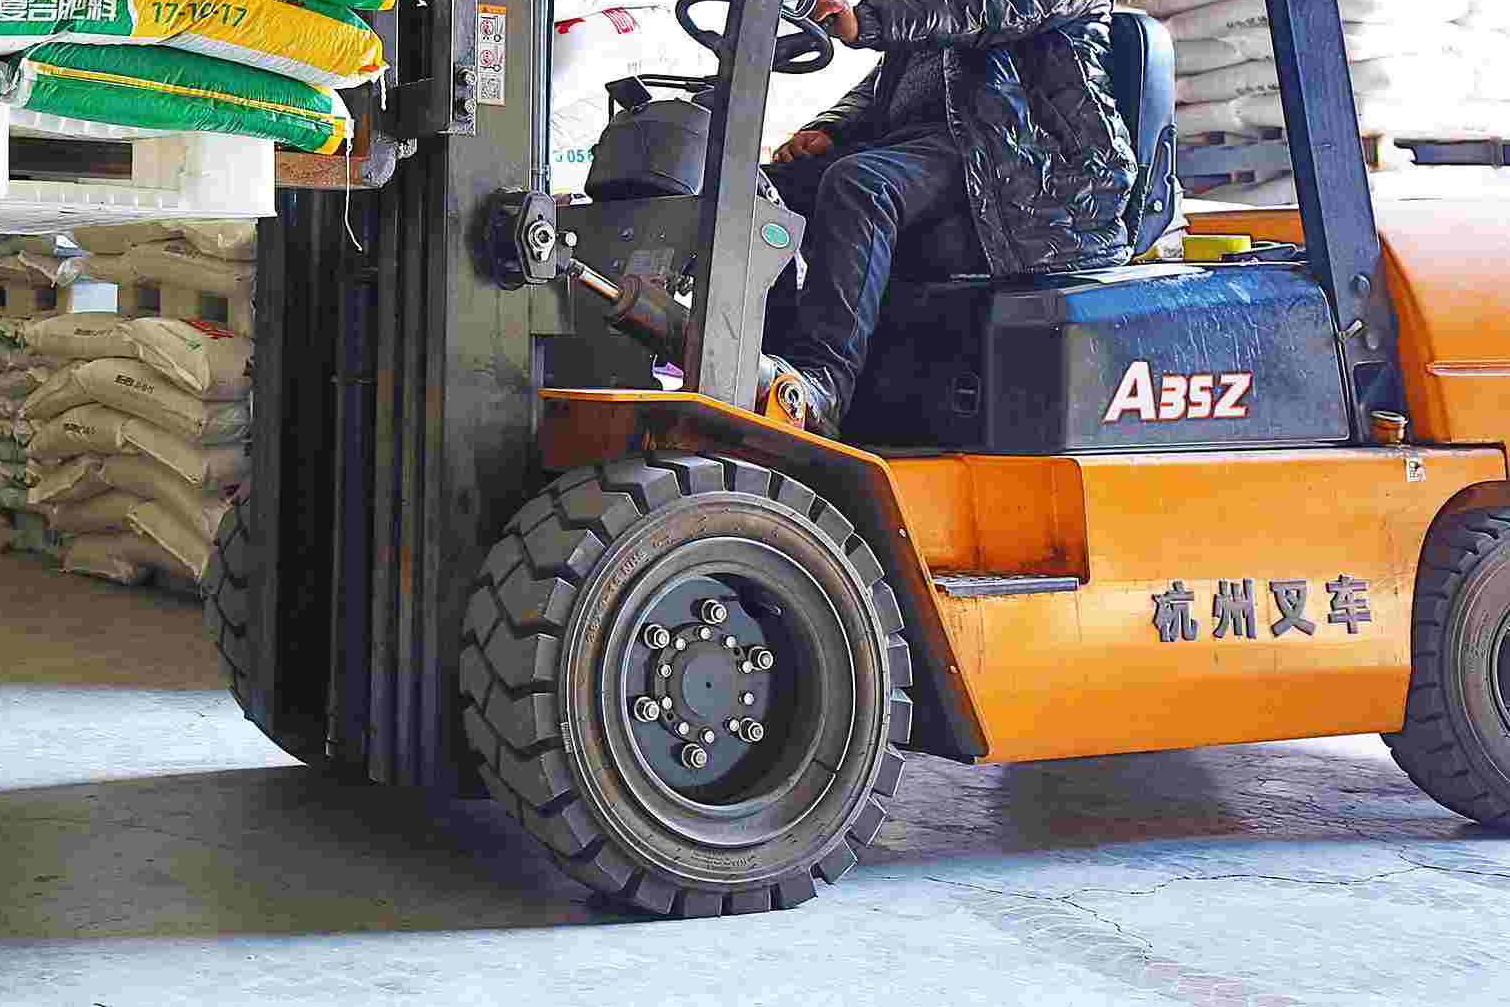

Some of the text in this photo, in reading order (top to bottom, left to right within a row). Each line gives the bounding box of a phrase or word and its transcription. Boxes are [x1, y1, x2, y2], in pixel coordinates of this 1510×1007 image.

[150, 0, 249, 28] 17-10-17
[1151, 574, 1374, 642] 杭州叉车
